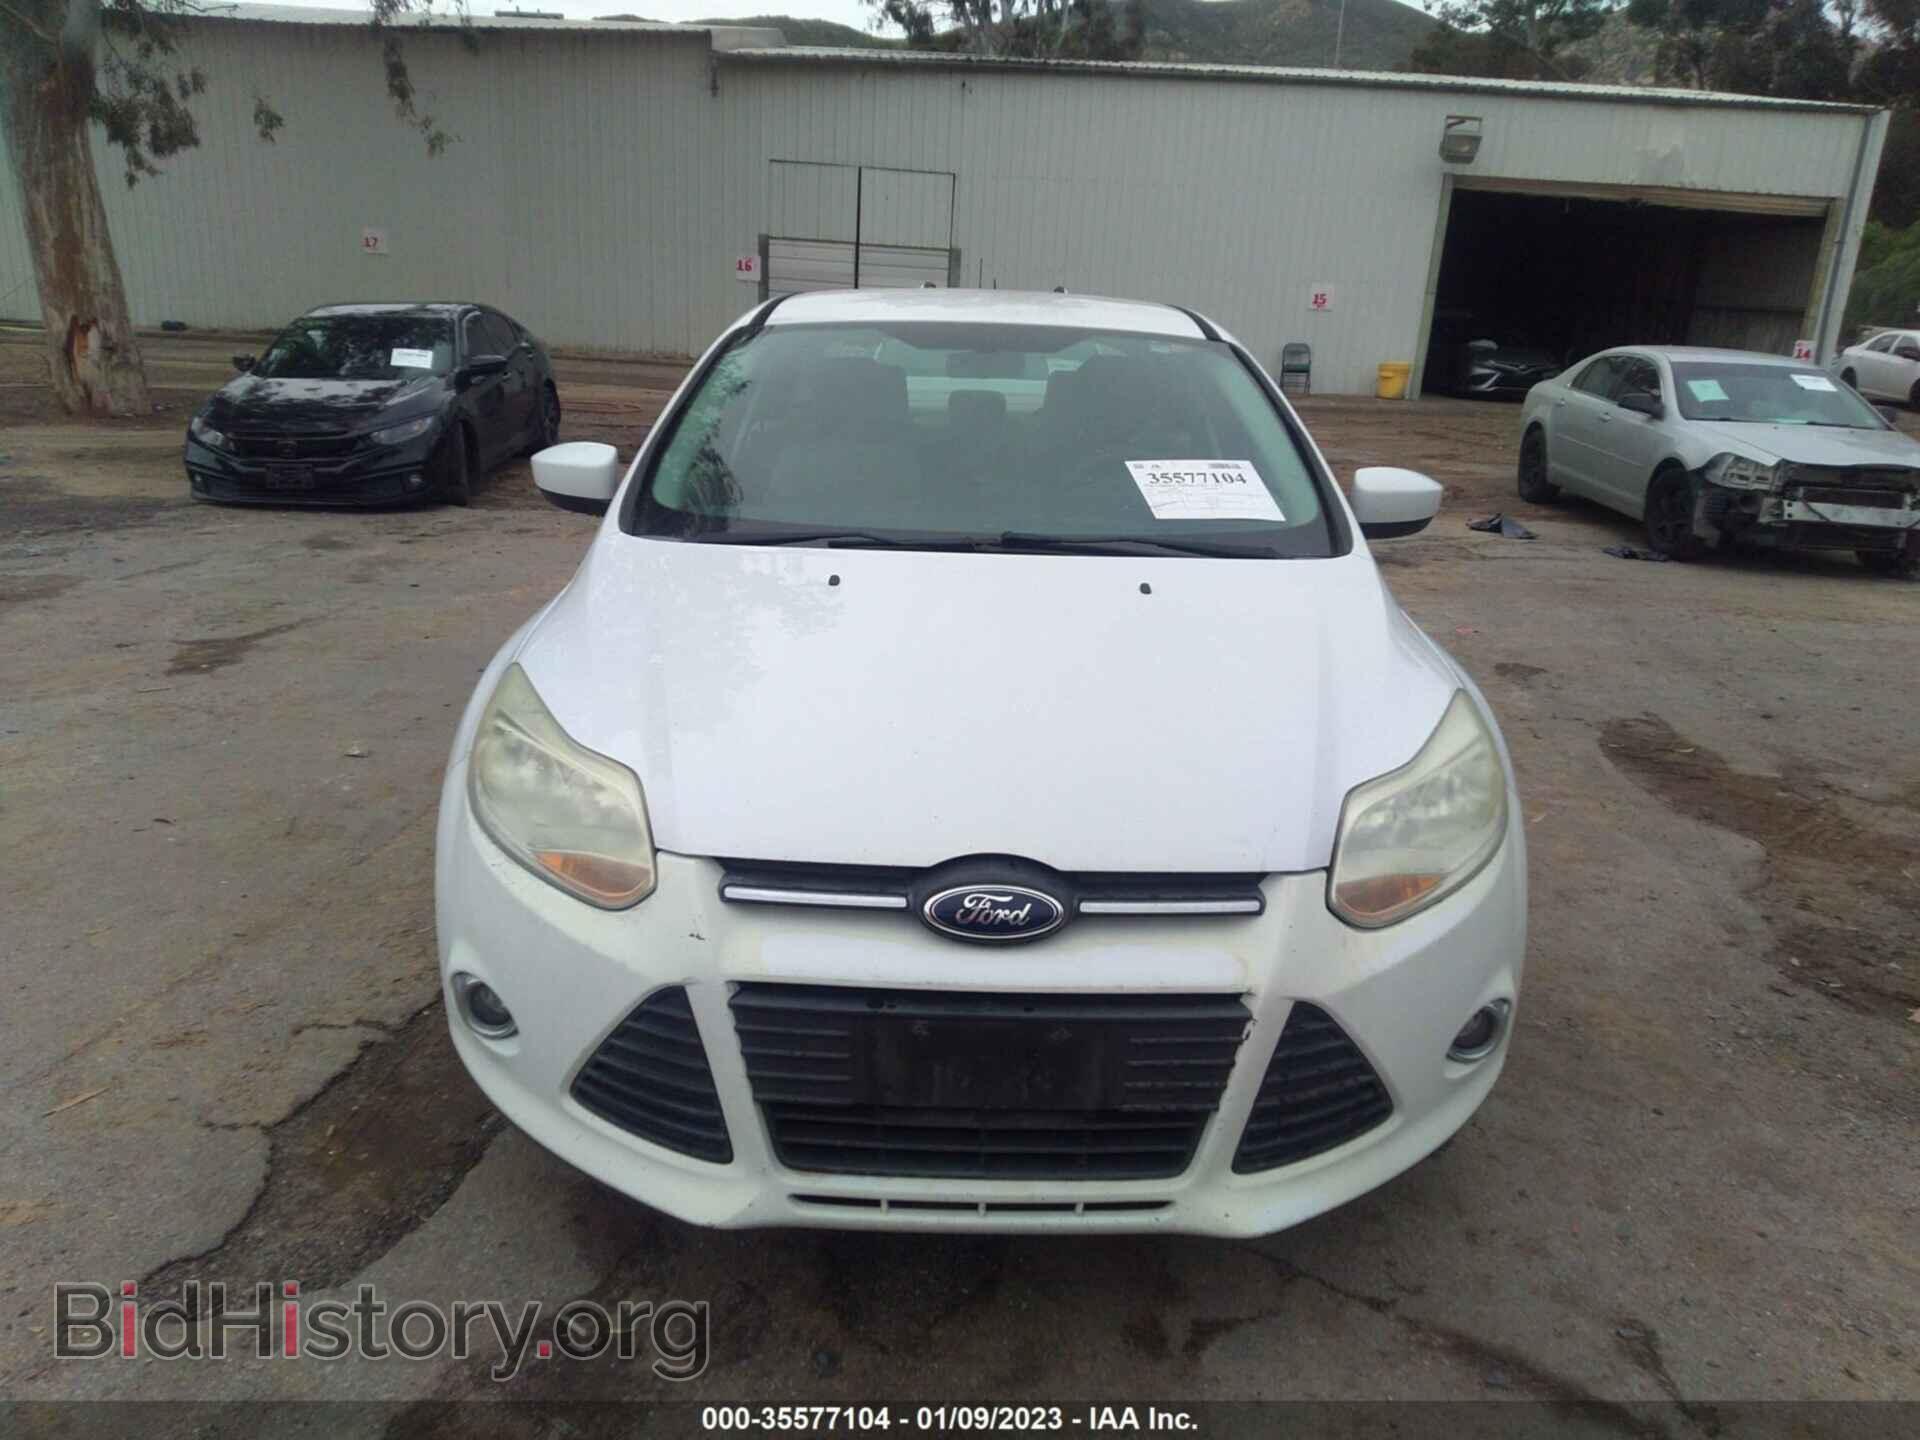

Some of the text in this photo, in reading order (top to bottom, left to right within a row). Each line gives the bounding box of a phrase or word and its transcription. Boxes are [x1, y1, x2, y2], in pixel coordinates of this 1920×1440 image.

[363, 236, 378, 248] 17
[736, 259, 753, 272] 16
[1311, 293, 1327, 305] 15
[1795, 348, 1811, 361] 14
[1147, 472, 1247, 484] 35577104
[955, 893, 1032, 926] Ford
